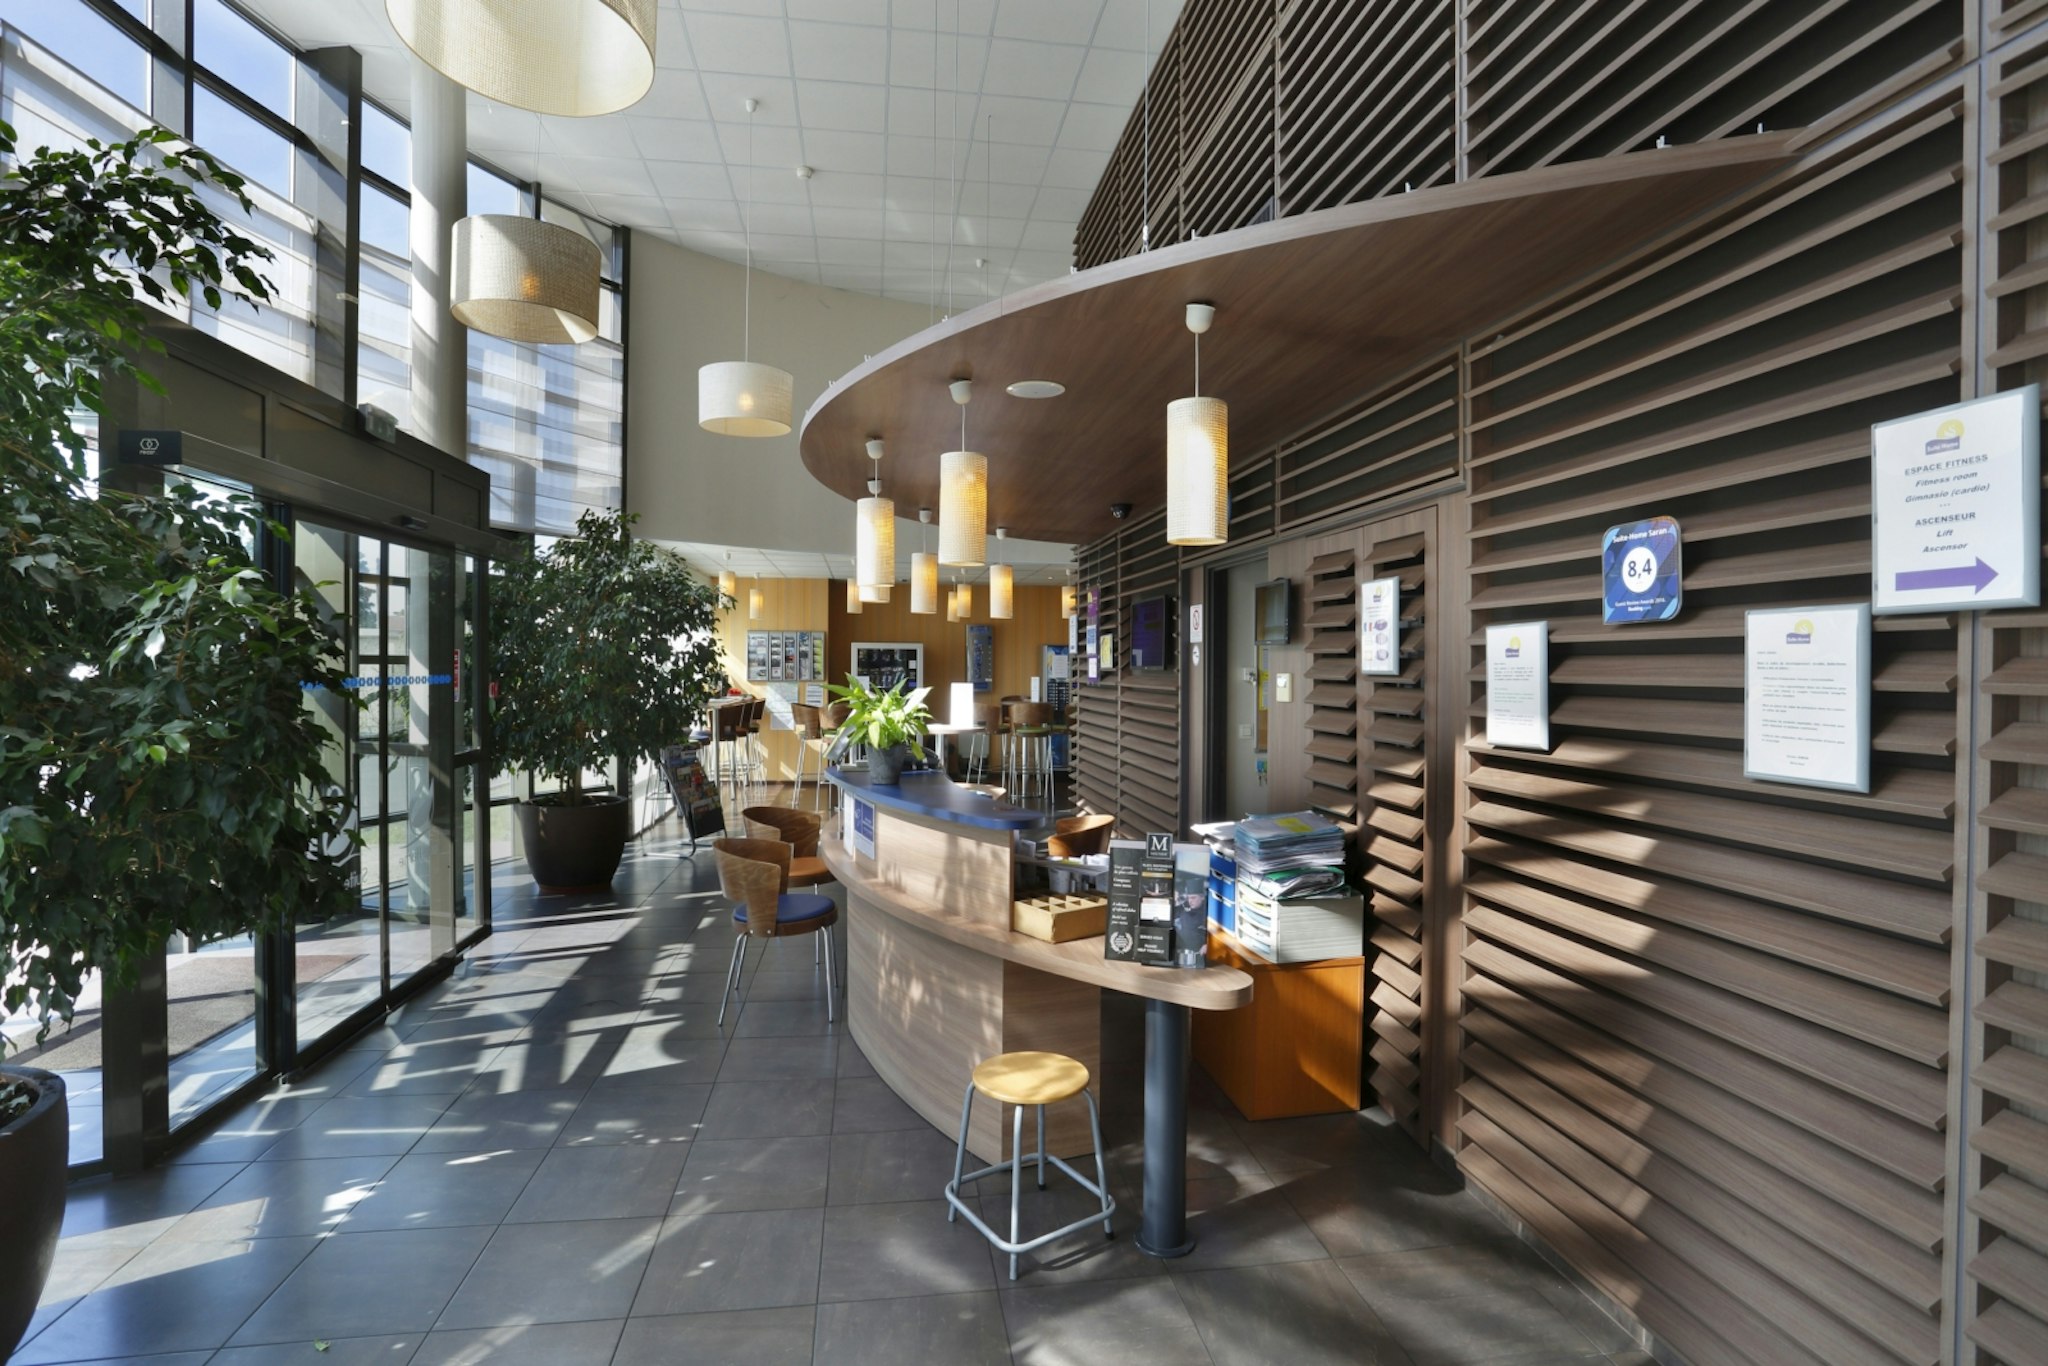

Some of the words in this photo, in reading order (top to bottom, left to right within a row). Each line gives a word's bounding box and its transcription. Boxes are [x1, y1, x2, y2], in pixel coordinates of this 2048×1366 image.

[1905, 462, 1942, 476] ESPACE
[1946, 454, 1988, 469] FITNESS
[1916, 477, 1950, 488] Fitness
[1953, 472, 1978, 481] room
[1905, 490, 1948, 503] Gimnasio
[1951, 483, 1990, 498] (cardio)
[1915, 512, 1976, 526] ASCENSEUR
[1936, 529, 1953, 538] Lift
[1922, 542, 1968, 553] Ascensor
[1628, 558, 1652, 578] 8,4
[1151, 836, 1168, 851] M
